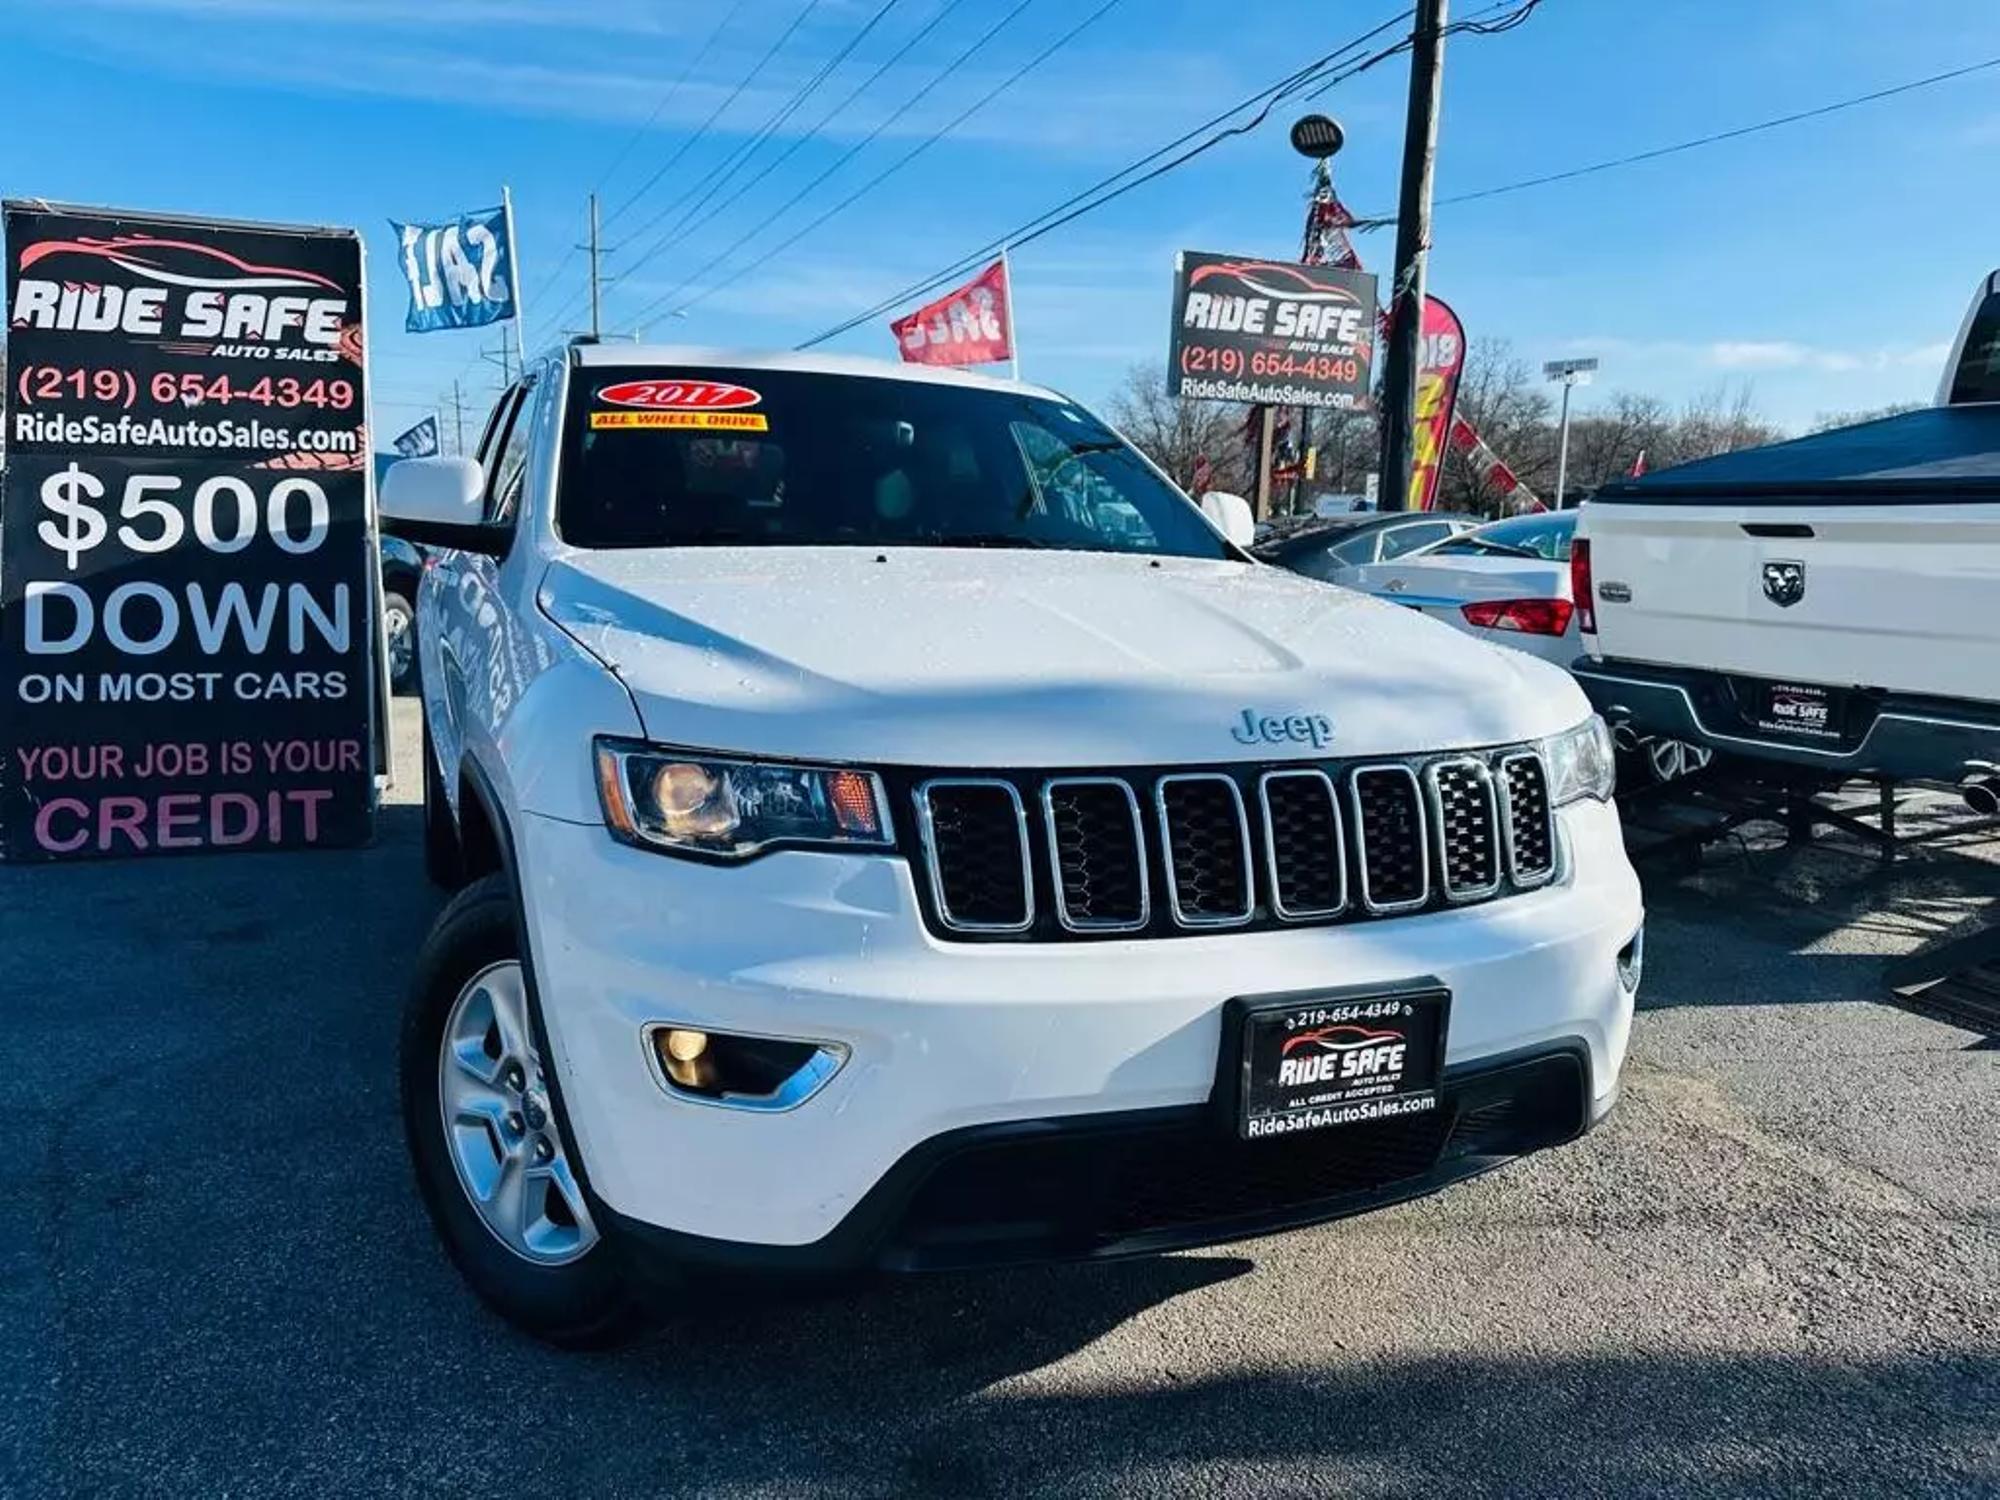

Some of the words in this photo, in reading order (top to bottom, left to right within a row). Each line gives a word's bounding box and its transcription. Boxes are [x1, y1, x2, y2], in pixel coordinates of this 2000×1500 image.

[12, 279, 168, 335] RIDE
[181, 291, 347, 344] SAFE
[1184, 291, 1270, 334] RIDE
[1273, 302, 1363, 342] SAFE
[212, 345, 270, 359] AUTO
[274, 348, 340, 362] SALES
[1181, 345, 1244, 378] (219)
[1251, 353, 1358, 382] 654-4349
[18, 366, 138, 408] (219)
[151, 372, 354, 409] 654-4349
[626, 385, 740, 404] 2017
[1180, 377, 1354, 408] RideSafeAutoSales.com
[16, 413, 357, 452] RideSafeAutoSales.com
[595, 414, 631, 426] ALL
[637, 414, 697, 426] WHEEL
[707, 415, 760, 427] DRIVE
[37, 461, 330, 571] $500
[24, 581, 351, 655] DOWN
[18, 674, 84, 702] ON
[99, 673, 223, 701] MOST
[234, 671, 348, 700] CARS
[1231, 707, 1336, 750] Jeep
[17, 743, 125, 780] YOUR
[134, 741, 209, 778] JOB
[221, 740, 253, 775] IS
[263, 739, 362, 774] YOUR
[34, 789, 334, 852] CREDIT
[1298, 1001, 1400, 1027] 219-654-4349
[1278, 1052, 1338, 1088] RIDE
[1340, 1044, 1406, 1079] SAFE
[1248, 1095, 1436, 1139] RideSafeAutoSales.com
